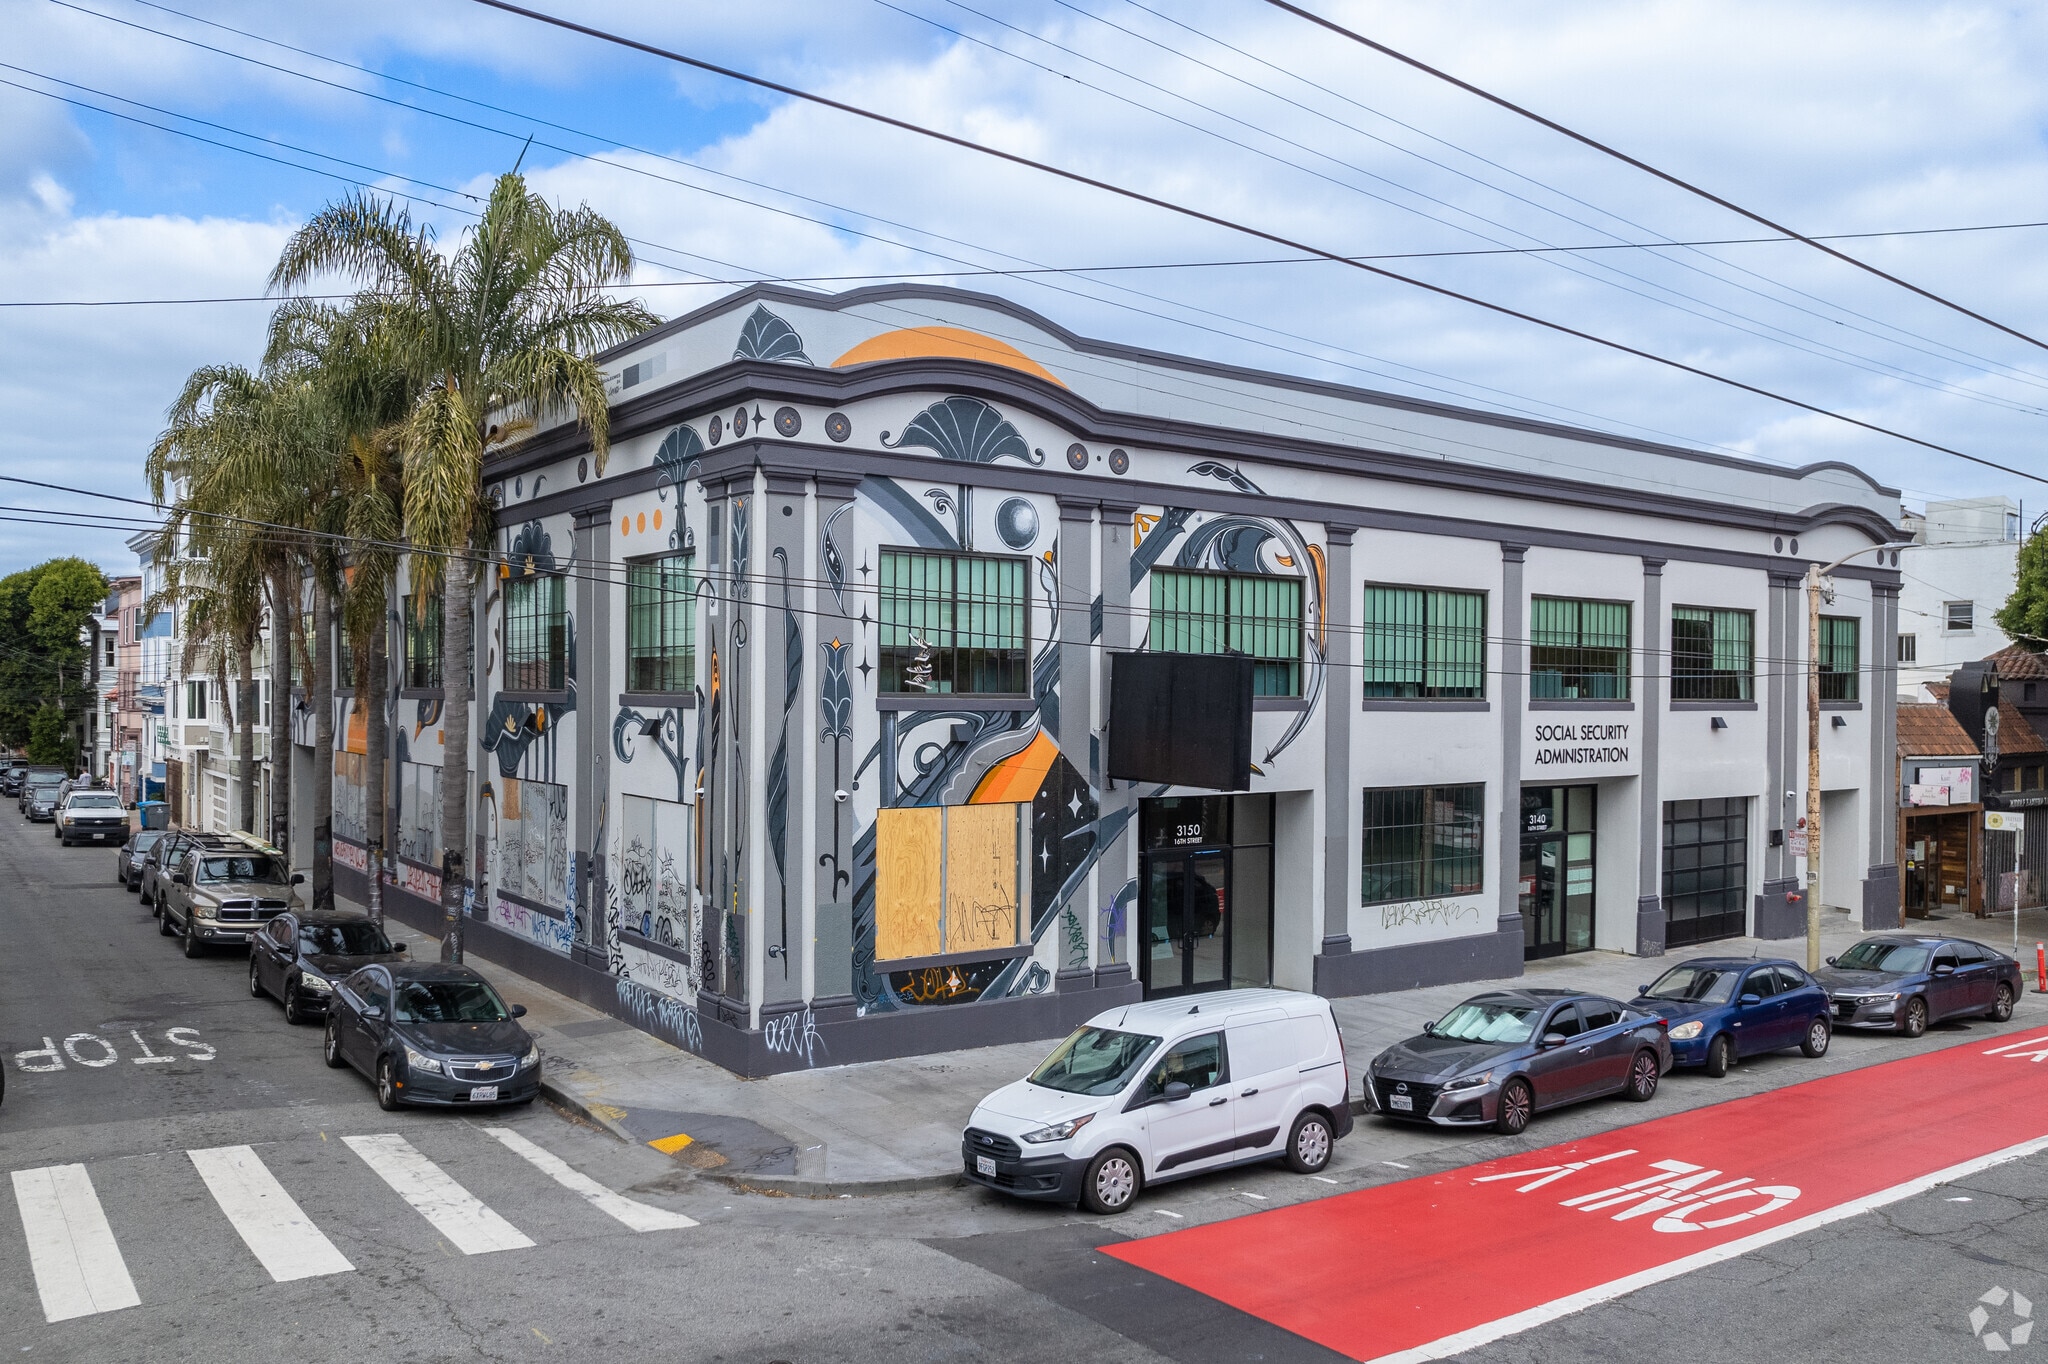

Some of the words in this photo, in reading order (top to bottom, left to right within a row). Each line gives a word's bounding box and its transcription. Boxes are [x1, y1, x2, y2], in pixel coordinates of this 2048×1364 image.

[1535, 725, 1577, 741] SOCIAL
[1580, 724, 1629, 740] SECURITY
[1535, 747, 1629, 764] ADMINISTRATION
[1529, 814, 1546, 824] 3140
[1176, 824, 1200, 836] 3150
[15, 1027, 217, 1073] STOP
[1473, 1149, 1801, 1233] ONLY
